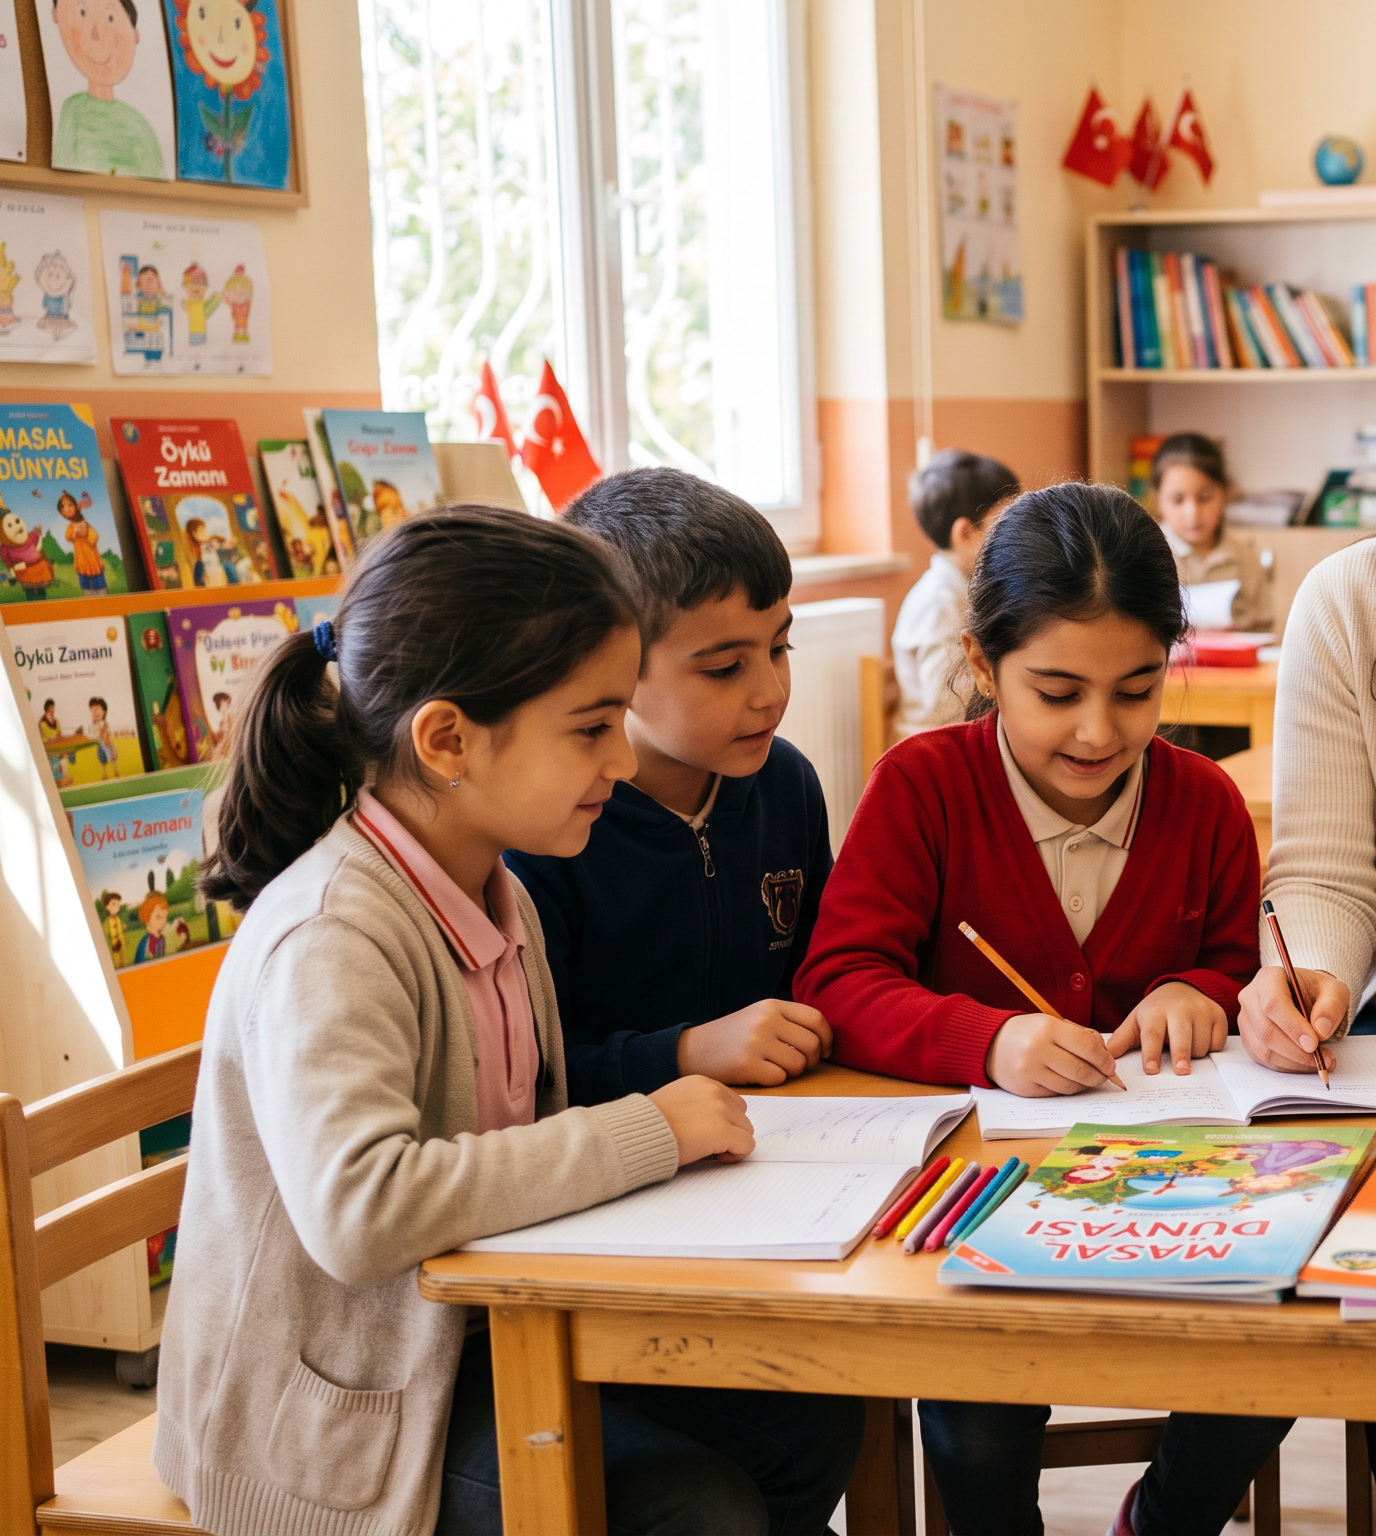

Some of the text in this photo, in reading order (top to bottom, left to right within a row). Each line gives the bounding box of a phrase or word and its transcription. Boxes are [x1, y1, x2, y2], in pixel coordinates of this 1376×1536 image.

[0, 427, 73, 451] MASAL
[161, 435, 212, 467] Öykü
[0, 452, 89, 481] DÜNYASI
[154, 466, 228, 487] Zamanı
[14, 645, 113, 671] Öykü Zamanı
[81, 822, 127, 851] Öykü
[132, 816, 192, 840] Zamanı
[1024, 1220, 1271, 1241] DÜNYASI
[1044, 1242, 1233, 1260] MASAL
